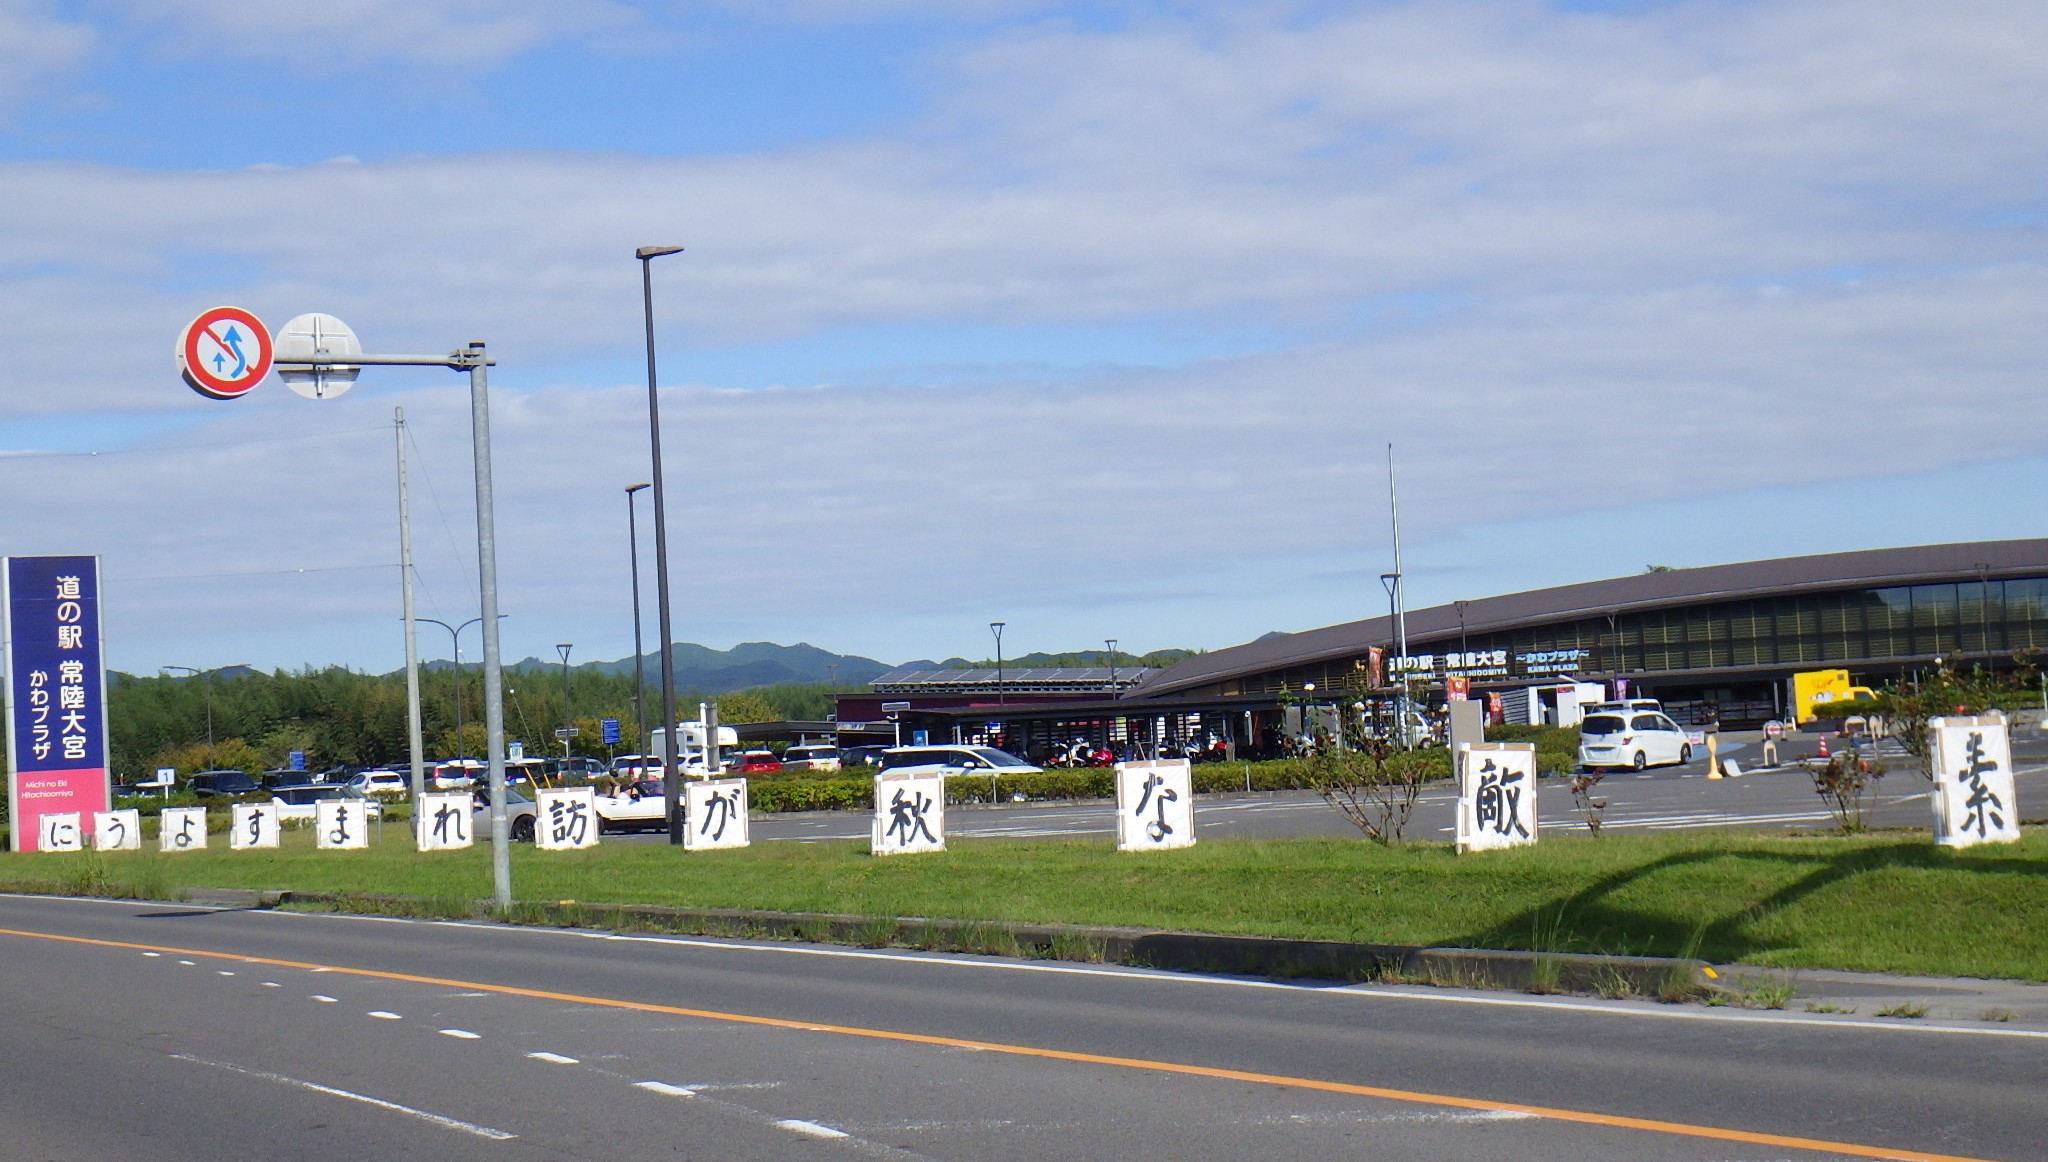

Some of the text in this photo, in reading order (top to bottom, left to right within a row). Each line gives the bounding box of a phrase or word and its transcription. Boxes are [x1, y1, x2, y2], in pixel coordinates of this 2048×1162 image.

[56, 575, 86, 761] 道の駅 常陸大宮
[1552, 663, 1579, 672] PLAZA
[29, 669, 52, 762] かわプラザ
[21, 789, 74, 799] Hitachioomiya
[26, 780, 45, 789] Michi
[57, 779, 68, 787] Eki
[1476, 758, 1530, 840] 敵
[1959, 731, 2004, 837] 素
[248, 809, 265, 846] す
[331, 805, 350, 845] ま
[433, 803, 467, 844] れ
[549, 799, 588, 845] 訪
[700, 787, 741, 842] が
[886, 788, 938, 846] 秋
[1135, 773, 1177, 842] な
[50, 822, 73, 846] に
[108, 816, 125, 849] う
[175, 814, 194, 848] よ
